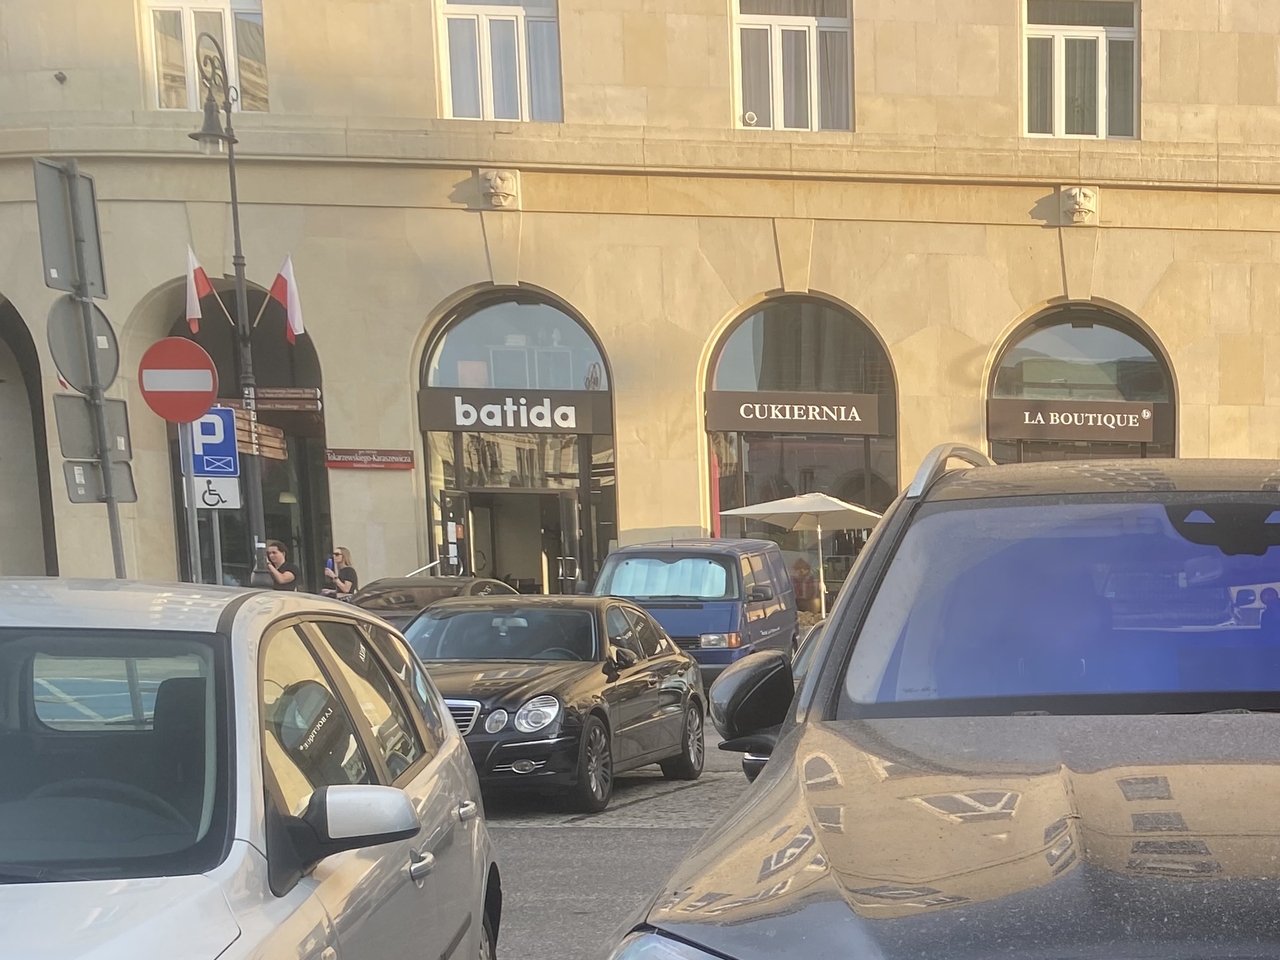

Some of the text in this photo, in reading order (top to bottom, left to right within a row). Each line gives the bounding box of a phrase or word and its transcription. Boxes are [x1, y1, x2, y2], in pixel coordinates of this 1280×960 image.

[454, 396, 576, 428] batida
[739, 403, 862, 422] CUKIERNIA
[1023, 411, 1045, 424] LA
[1049, 412, 1140, 429] BOUTIQUE
[192, 414, 224, 455] P
